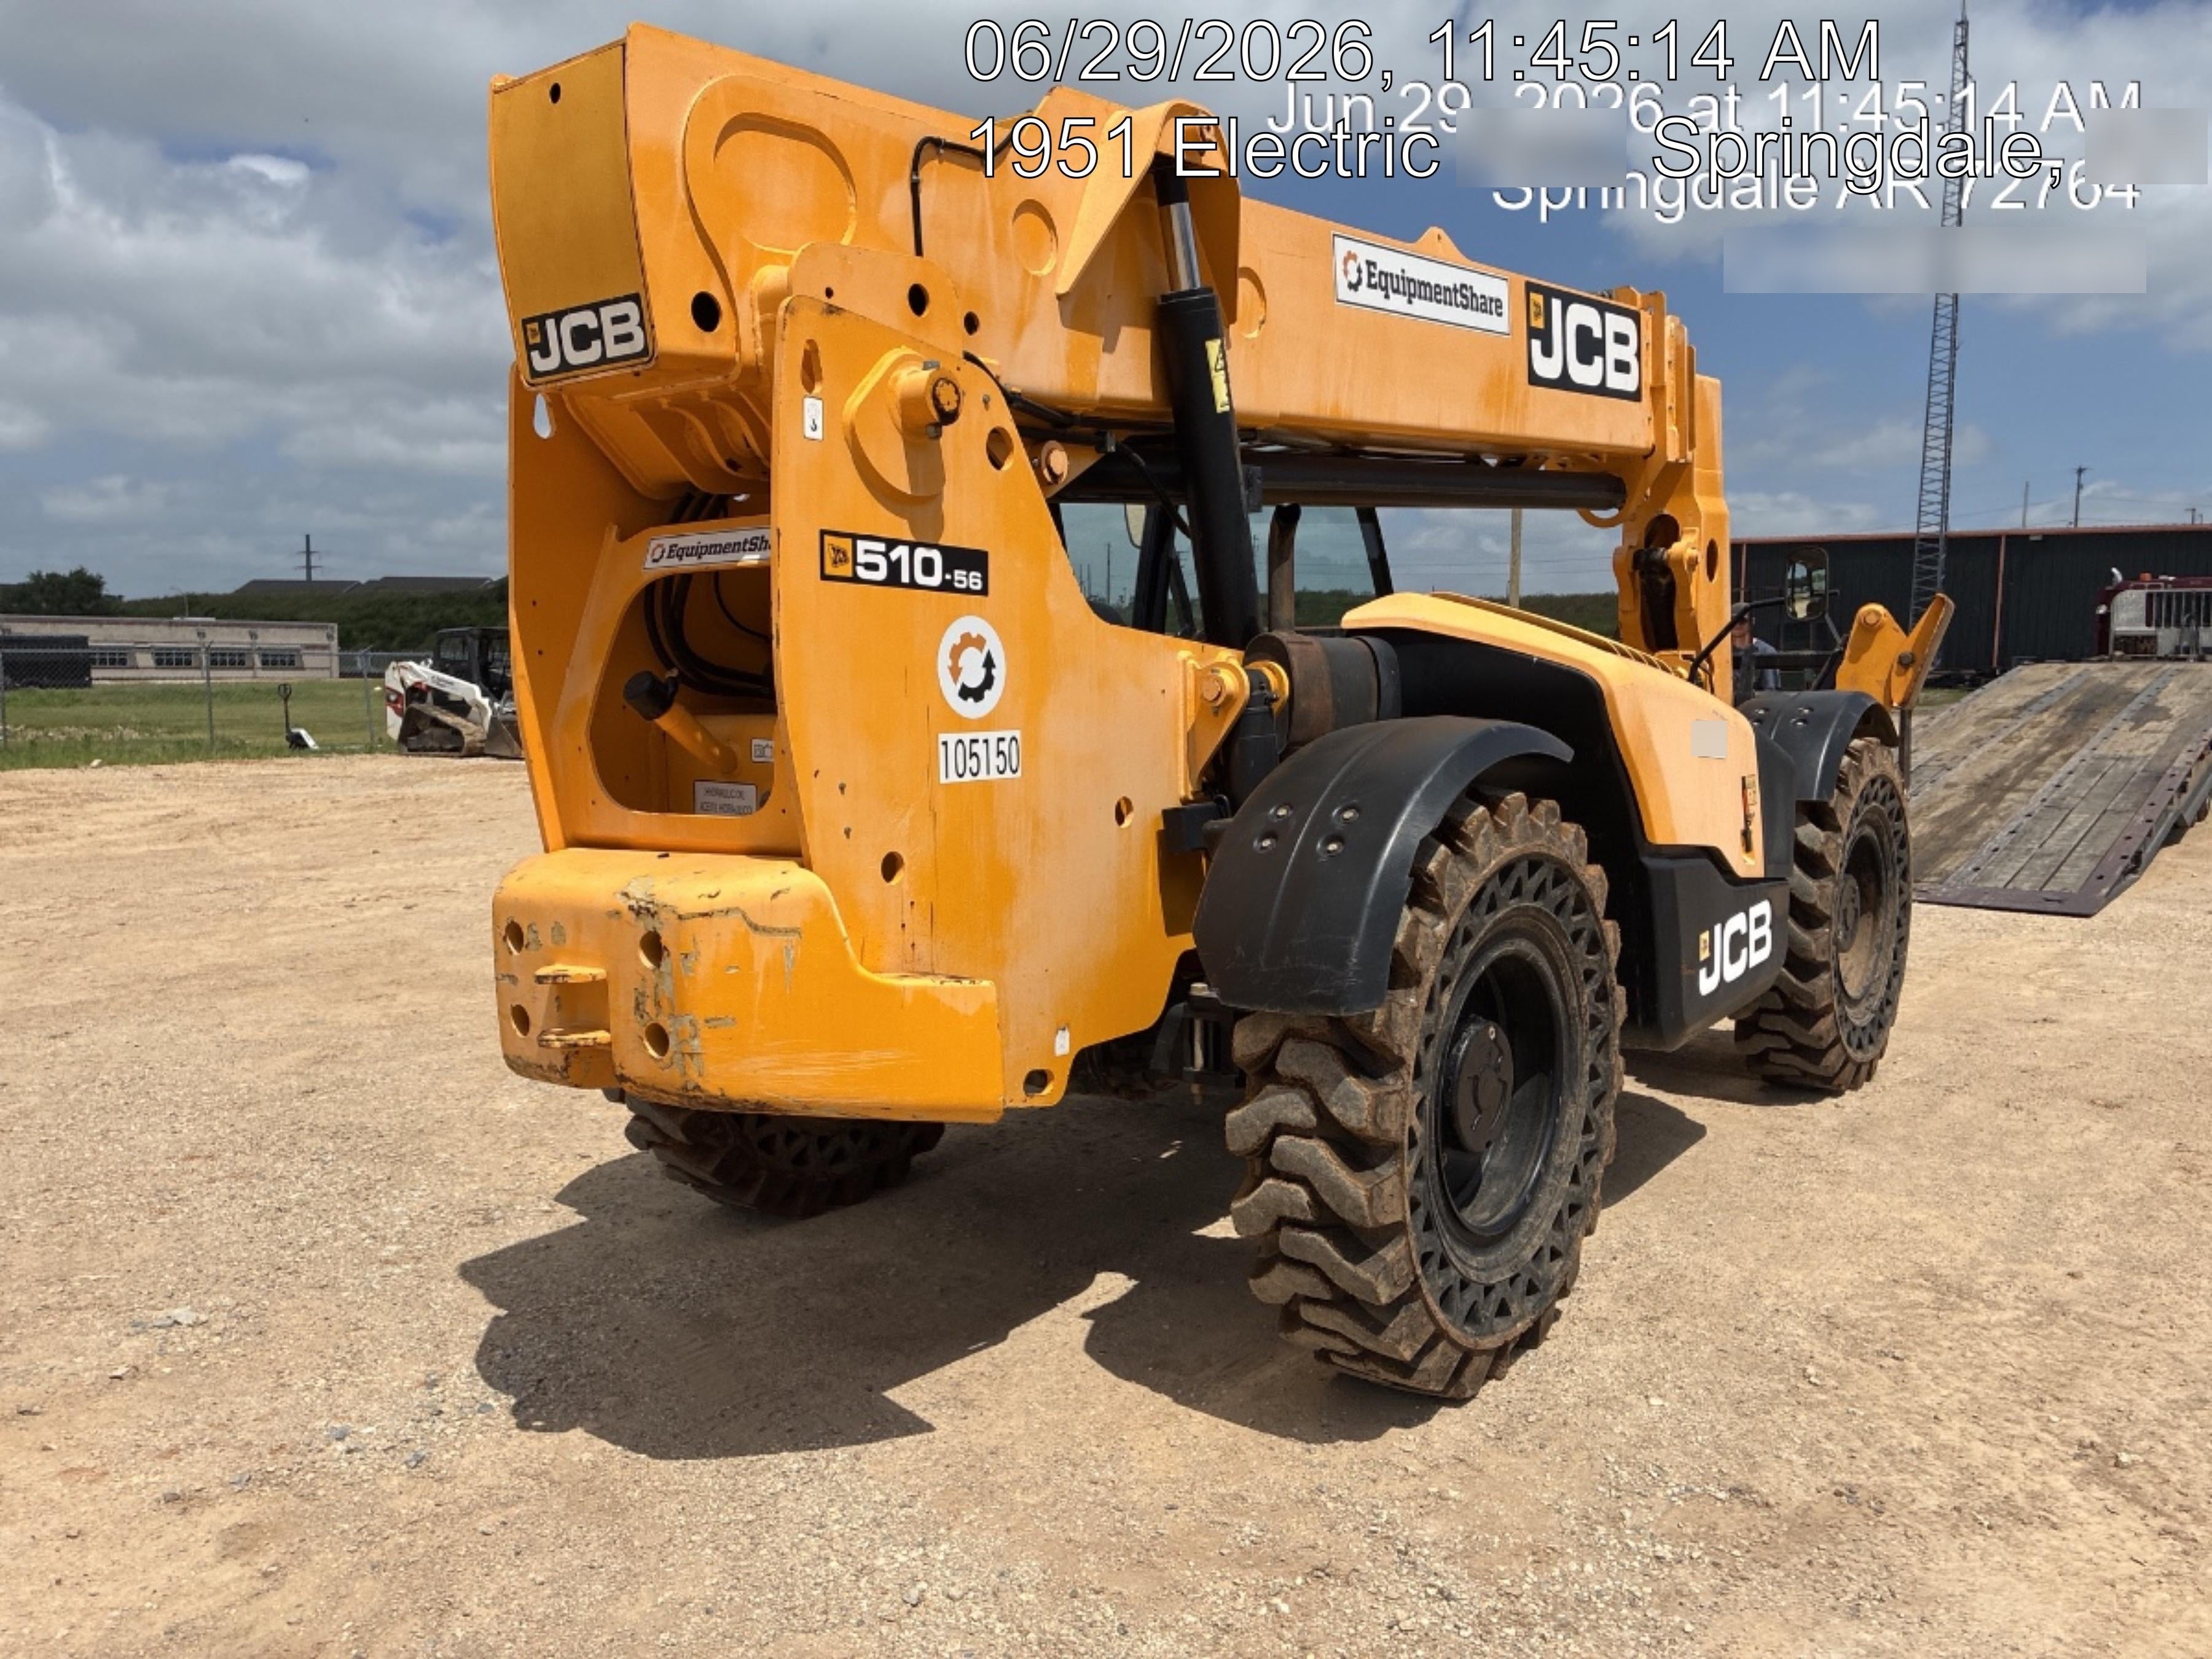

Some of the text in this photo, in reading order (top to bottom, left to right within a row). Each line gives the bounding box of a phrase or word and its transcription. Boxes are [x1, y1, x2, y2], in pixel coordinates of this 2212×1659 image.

[1365, 259, 1504, 318] EquipmentShare
[530, 300, 645, 372] JCB
[1530, 297, 1639, 392] JCB
[666, 534, 771, 561] EquipmentSh
[941, 736, 1021, 779] 105150
[1698, 899, 1773, 997] JCB
